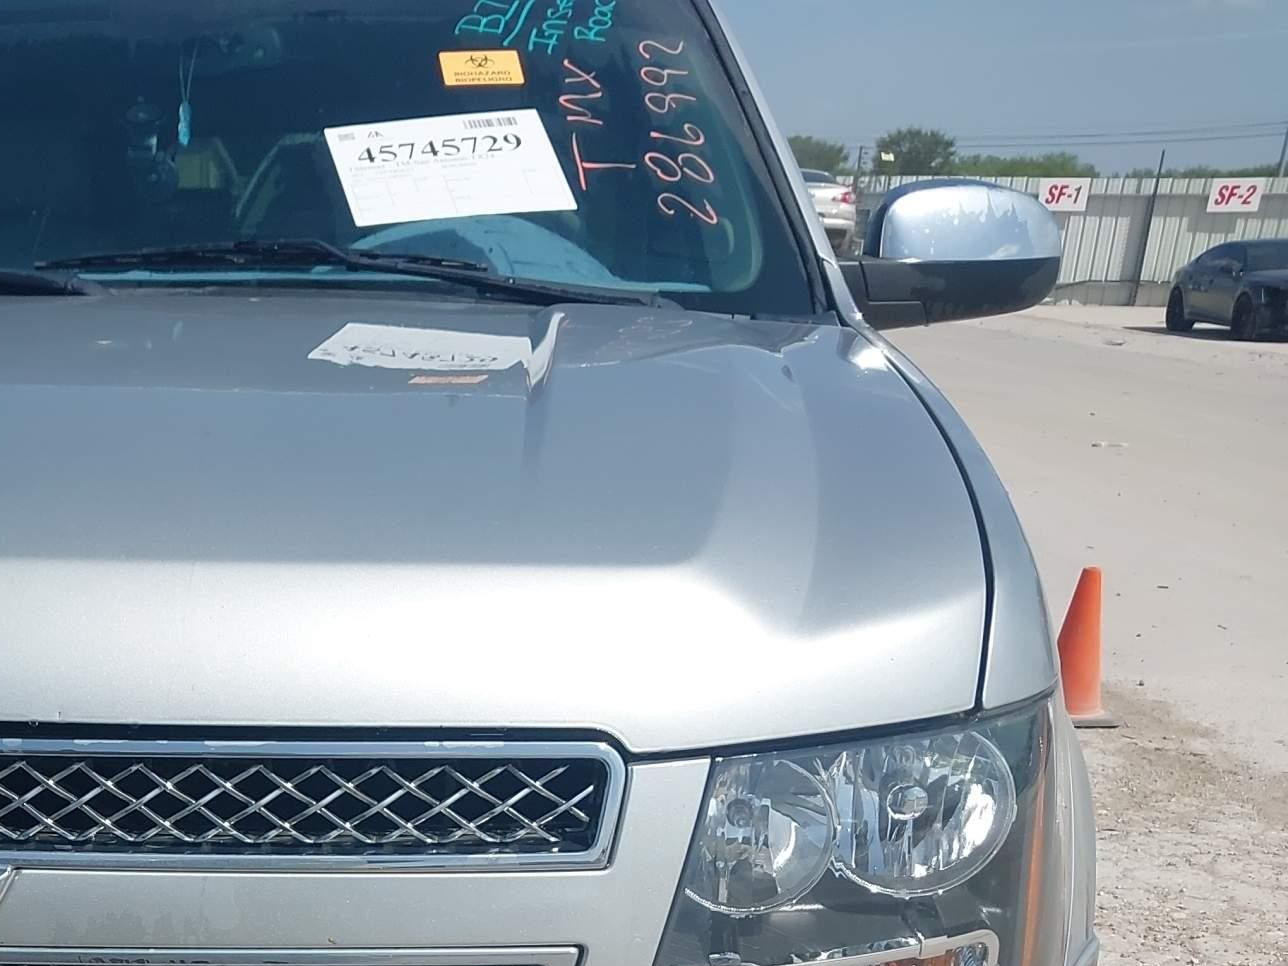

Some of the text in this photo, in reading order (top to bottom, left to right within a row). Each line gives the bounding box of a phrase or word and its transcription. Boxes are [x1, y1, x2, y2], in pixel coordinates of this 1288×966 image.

[637, 39, 718, 225] 286992
[357, 133, 522, 164] 45745729
[1044, 184, 1083, 205] SF-1
[1214, 184, 1258, 206] SF-2
